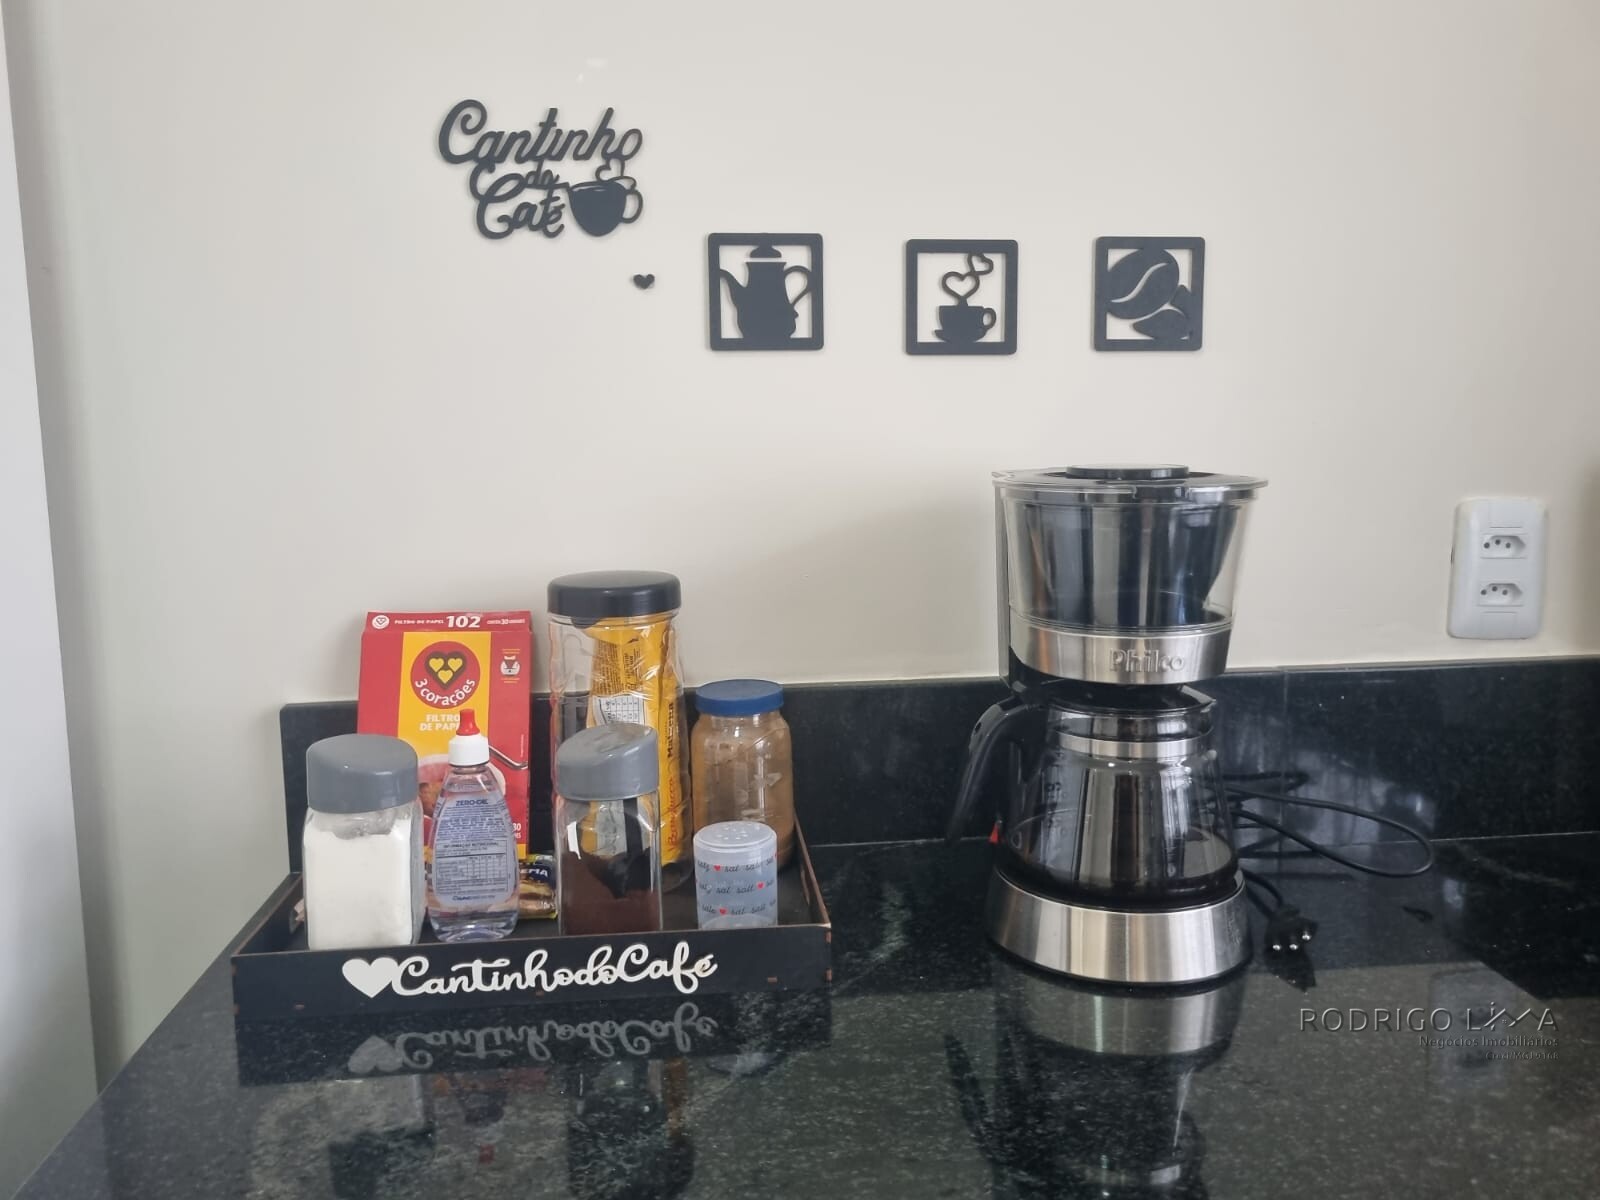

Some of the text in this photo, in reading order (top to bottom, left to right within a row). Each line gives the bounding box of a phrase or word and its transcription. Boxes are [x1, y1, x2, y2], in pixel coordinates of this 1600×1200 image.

[438, 99, 643, 165] Cantinho
[446, 615, 481, 628] 102
[1110, 649, 1186, 672] Philco
[415, 678, 476, 706] 3 corações
[426, 713, 461, 722] FILTRO
[420, 723, 433, 731] DE
